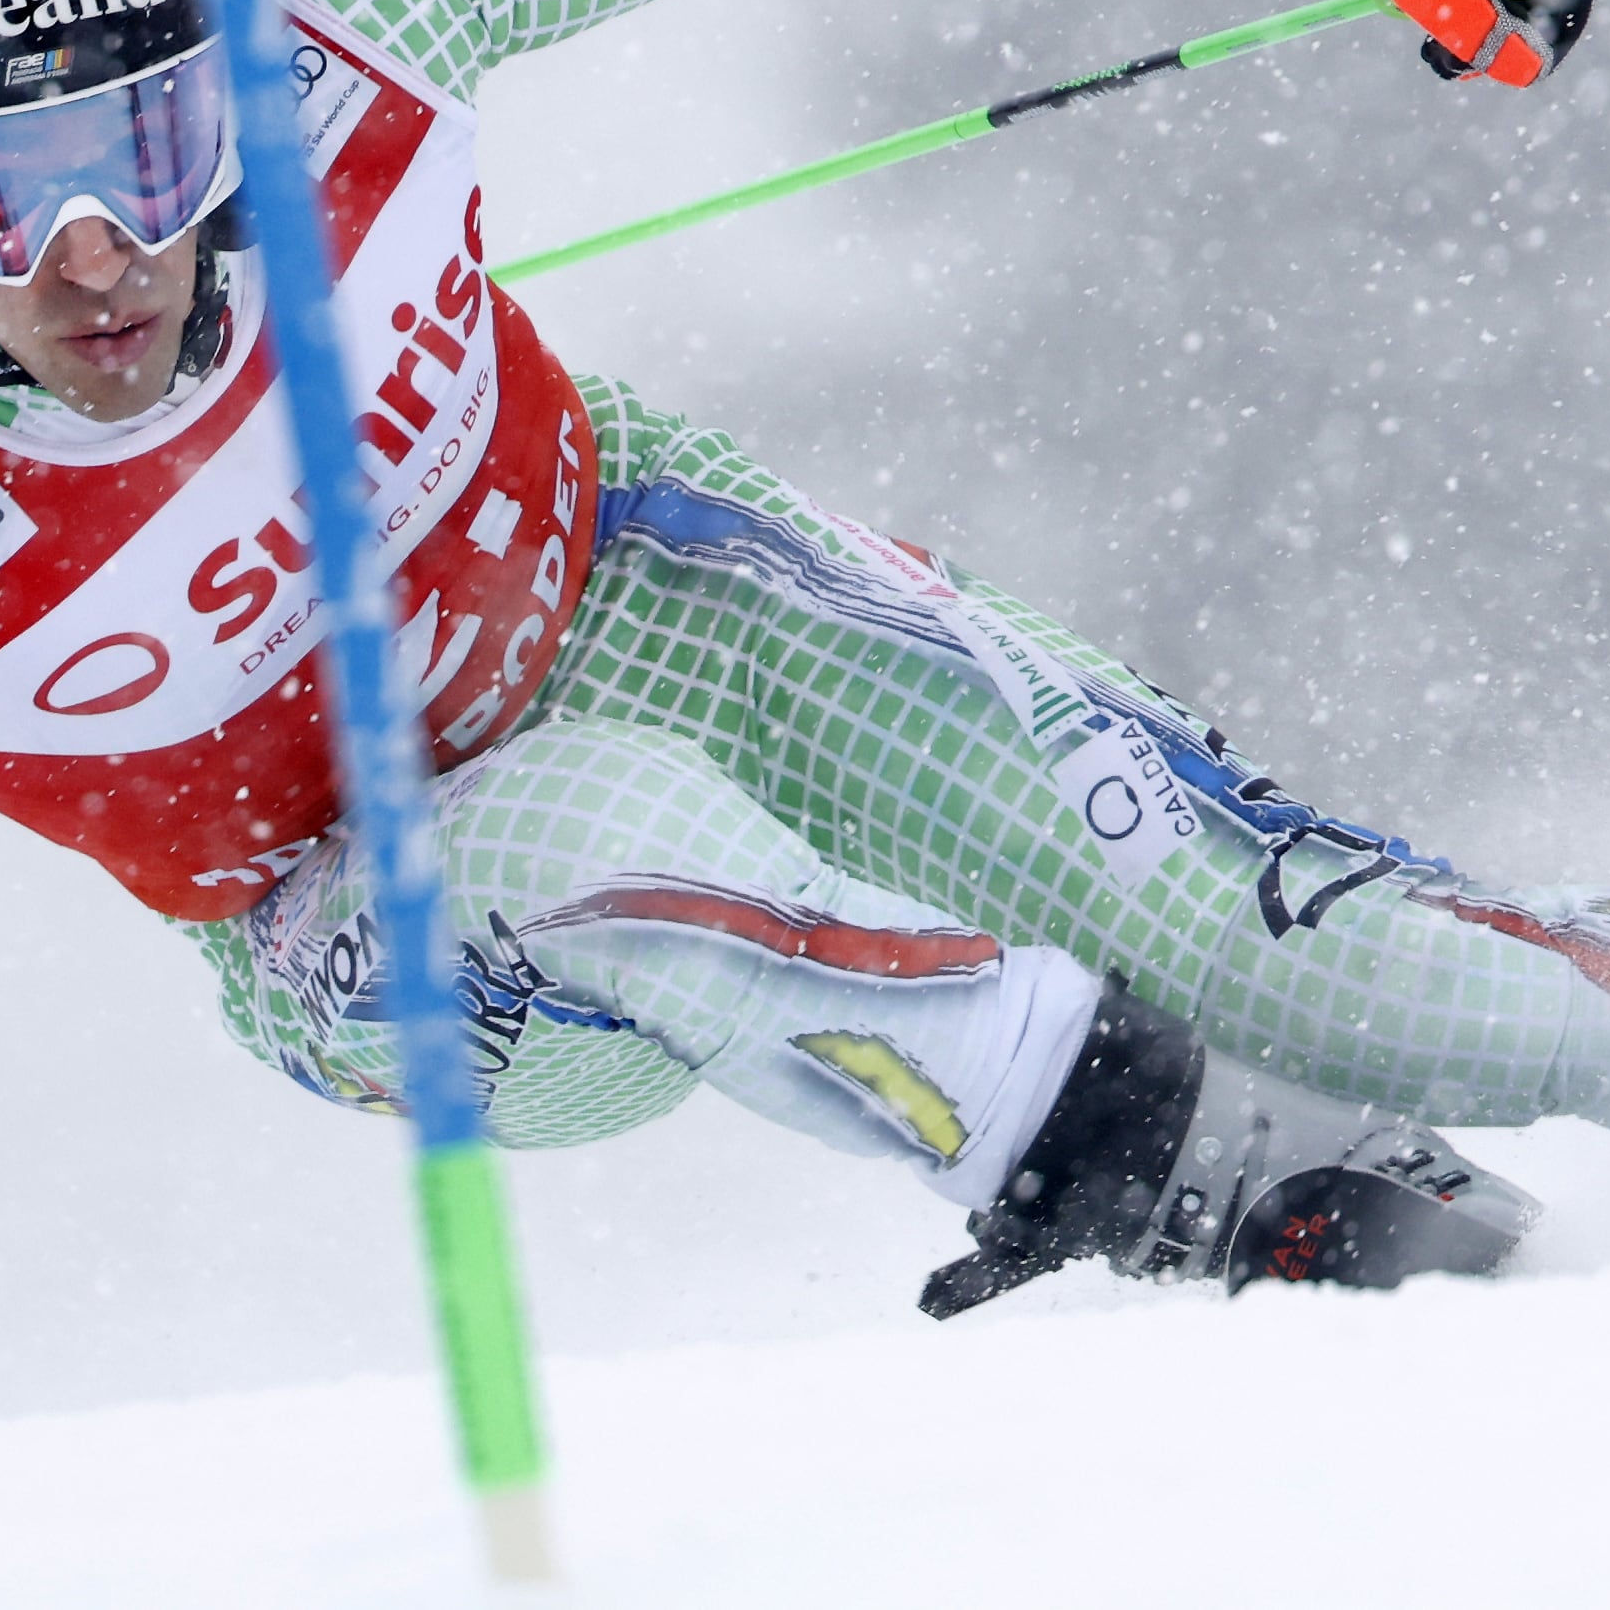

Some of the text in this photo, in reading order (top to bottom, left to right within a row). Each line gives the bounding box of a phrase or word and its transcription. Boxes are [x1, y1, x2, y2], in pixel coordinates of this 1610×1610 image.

[322, 98, 346, 129] World
[343, 79, 360, 99] Cup
[239, 595, 331, 676] DREA
[373, 502, 420, 554] IG.
[419, 437, 462, 496] DO
[1120, 722, 1196, 837] CALDEA
